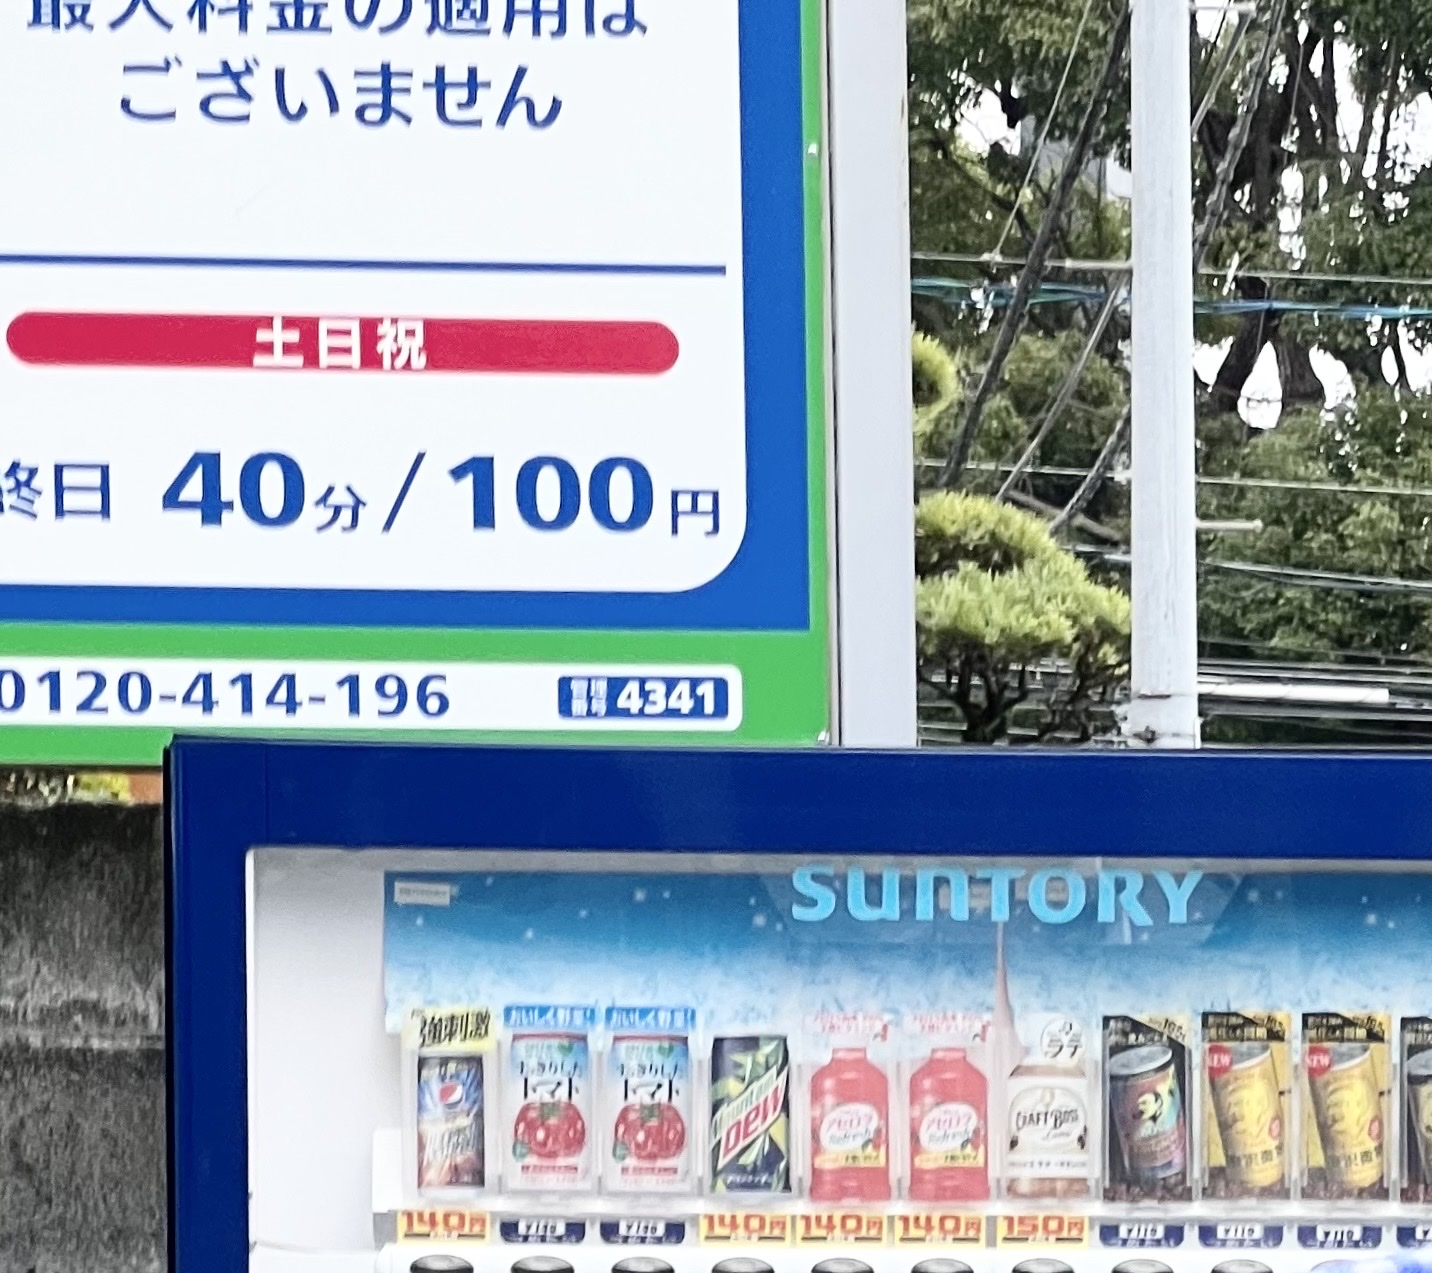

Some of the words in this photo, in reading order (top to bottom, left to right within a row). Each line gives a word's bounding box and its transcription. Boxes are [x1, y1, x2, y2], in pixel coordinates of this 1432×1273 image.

[119, 57, 563, 131] ございません
[252, 316, 428, 371] 土日祝
[0, 460, 112, 523] 終日
[0, 668, 450, 719] 0120-414-196
[616, 678, 715, 715] 4341
[790, 863, 1203, 927] SUNTORY
[401, 1211, 487, 1232] 140円
[704, 1214, 787, 1235] 140円
[800, 1214, 883, 1236] 140円
[898, 1214, 981, 1236] 140円
[1002, 1215, 1085, 1237] 150円
